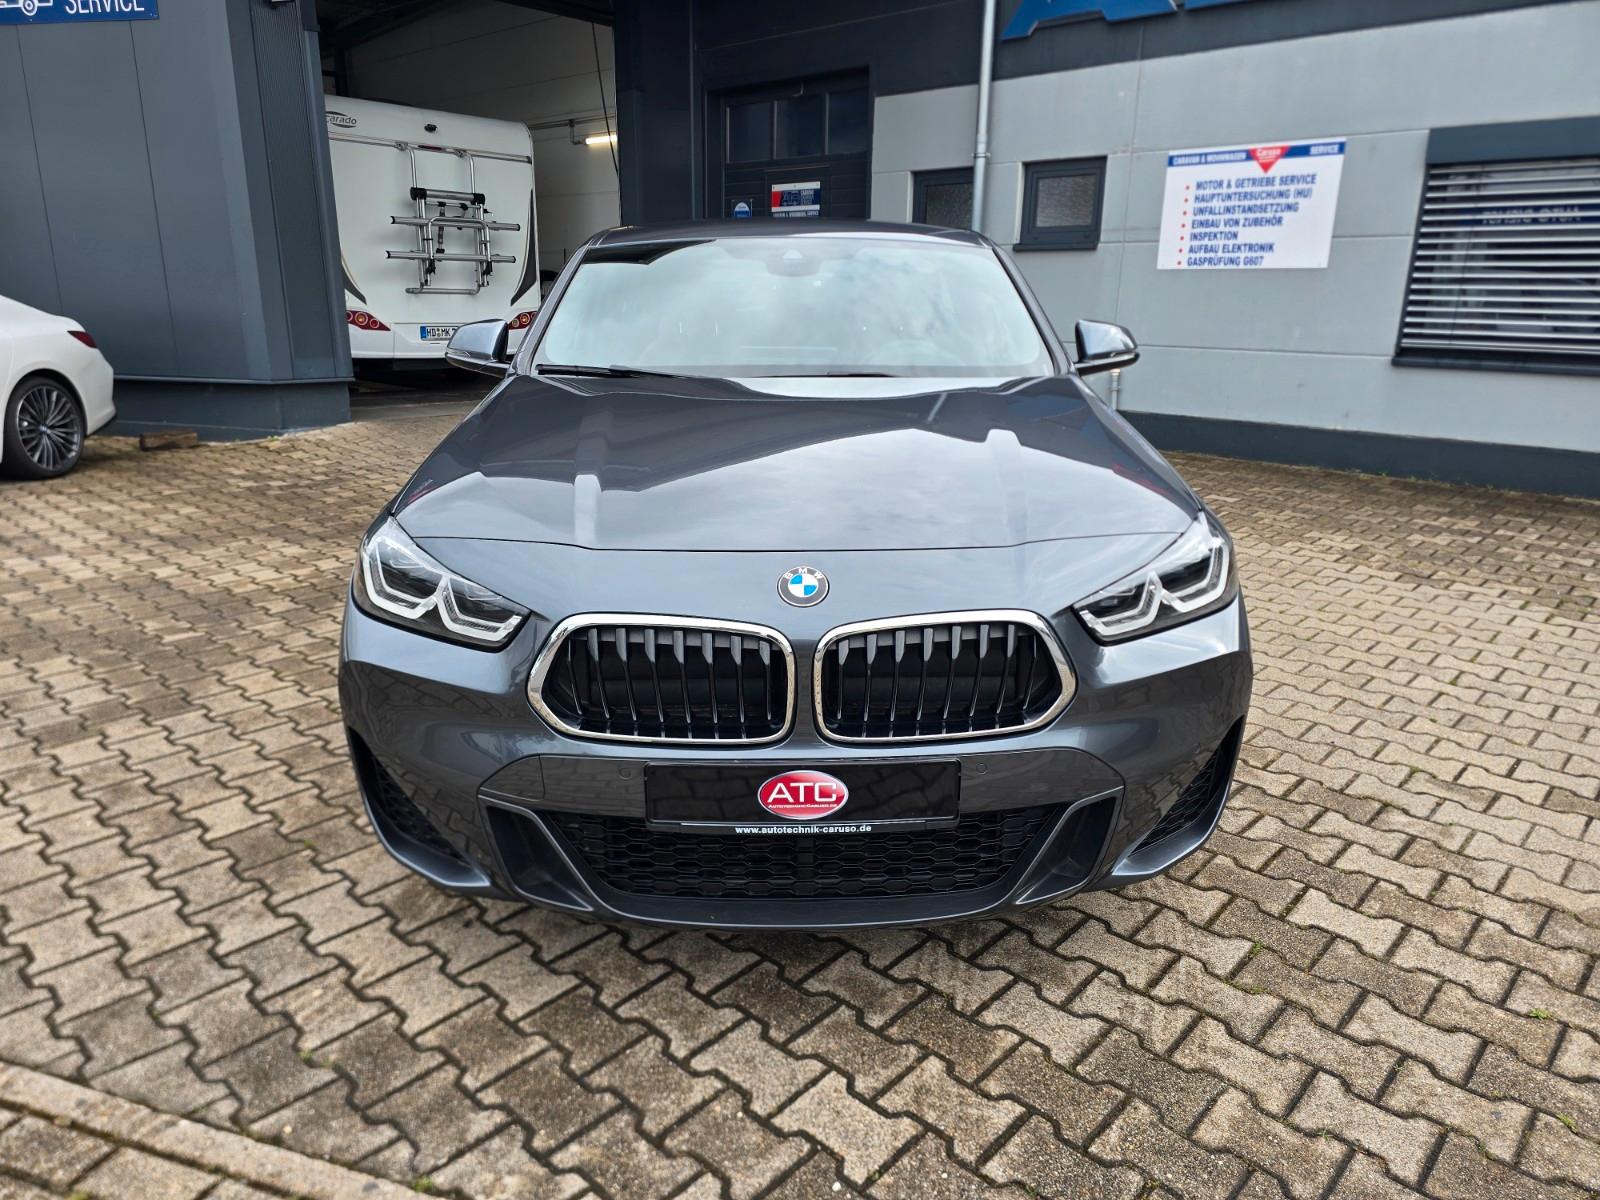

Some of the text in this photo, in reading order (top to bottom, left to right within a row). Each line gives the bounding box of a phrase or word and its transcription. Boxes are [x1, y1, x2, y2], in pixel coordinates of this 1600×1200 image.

[1196, 174, 1317, 191] MOTOR & GETRIEBE SERVICE
[1194, 188, 1313, 204] HAUPTUNTERSUCHUNG (HU)
[1193, 202, 1299, 216] UNFALLINSTANDSETZUNG
[1191, 215, 1284, 229] EINBAU VON ZUBEHÖR
[1190, 230, 1238, 242] INSPEKTION
[1188, 242, 1275, 254] AUFBAU ELEKTRONIK
[1187, 255, 1265, 267] GASPRÜFUNG G607
[426, 328, 437, 337] HD
[783, 567, 824, 580] BMW
[767, 782, 837, 803] ATC
[735, 824, 872, 834] www.autotechnik-caruso.de
